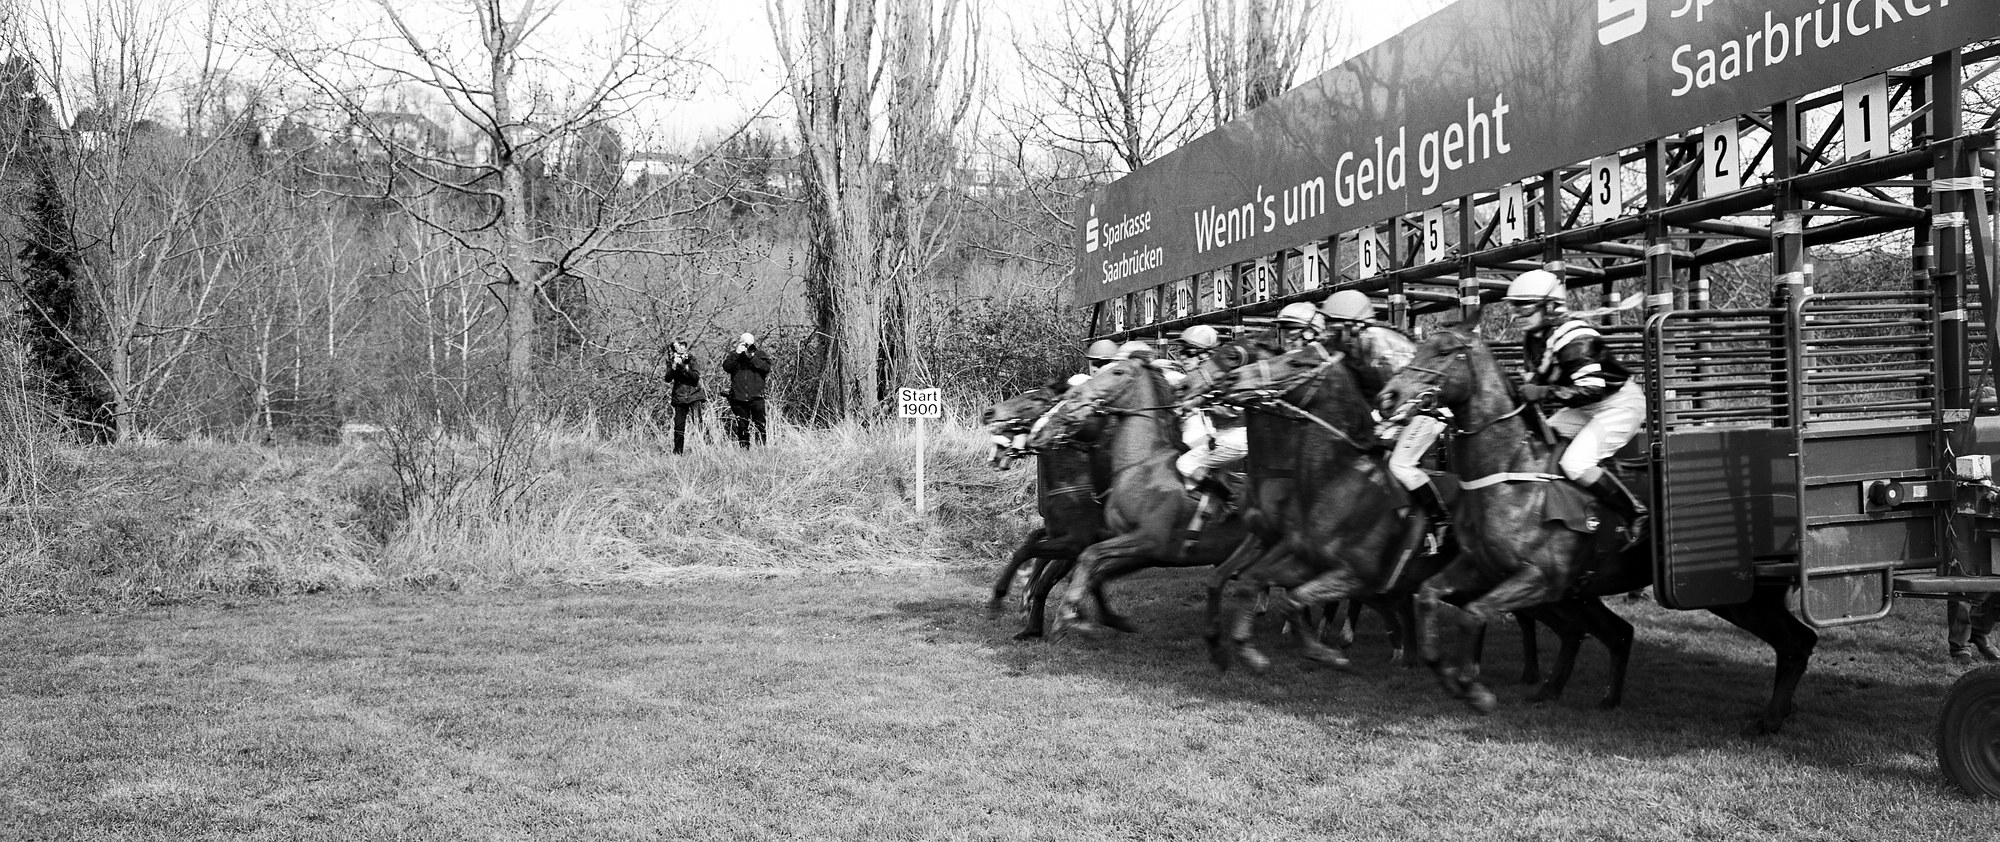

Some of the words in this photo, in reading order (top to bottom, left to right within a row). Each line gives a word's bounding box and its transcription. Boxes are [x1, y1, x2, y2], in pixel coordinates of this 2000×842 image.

[1671, 0, 1949, 97] Saarbrück
[1859, 95, 1871, 142] 1
[1283, 176, 1325, 226] um
[1335, 126, 1406, 207] Geld
[1418, 93, 1511, 195] geht
[1714, 134, 1728, 178] 2
[1600, 167, 1611, 205] 3
[1506, 196, 1516, 230] 4
[1103, 211, 1152, 251] Sparkasse
[1429, 219, 1438, 250] 5
[1103, 245, 1163, 284] Saarbrücken
[1308, 255, 1314, 282] 7
[1363, 240, 1371, 268] 6
[1217, 279, 1223, 302] 9
[1258, 266, 1266, 292] 8
[1146, 296, 1152, 318] 11
[1178, 288, 1186, 311] 10
[1116, 304, 1123, 325] 12
[902, 390, 938, 401] Start
[902, 403, 938, 415] 1900
